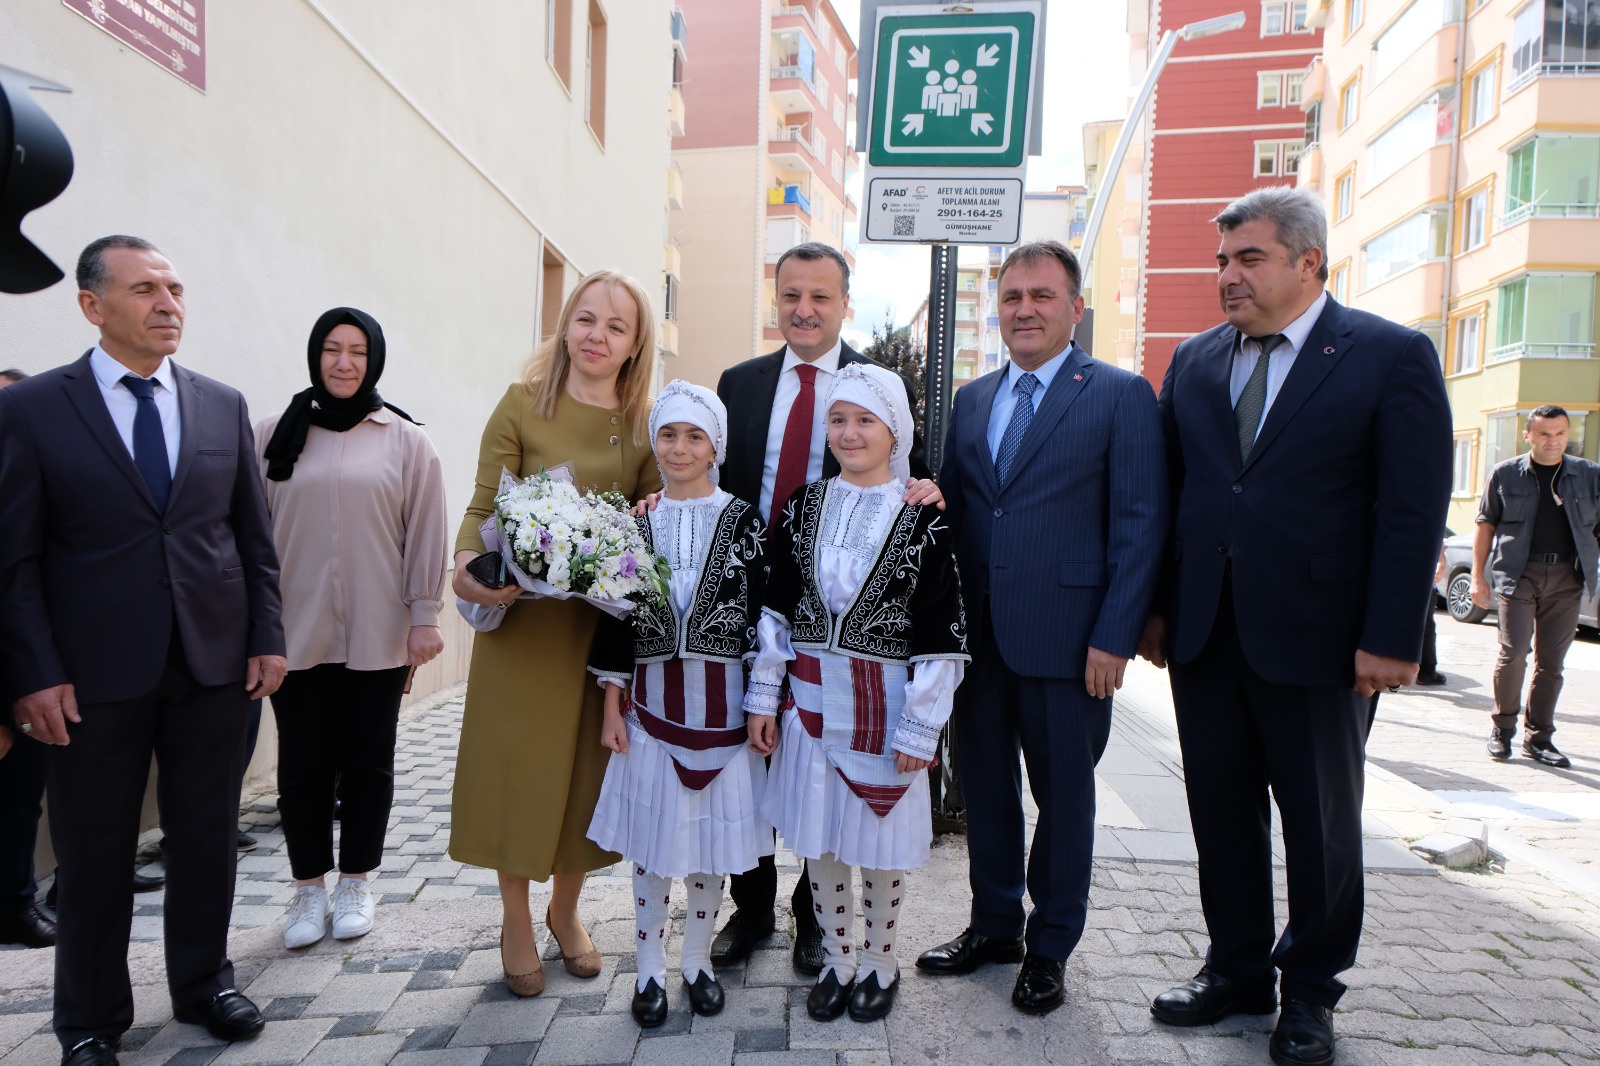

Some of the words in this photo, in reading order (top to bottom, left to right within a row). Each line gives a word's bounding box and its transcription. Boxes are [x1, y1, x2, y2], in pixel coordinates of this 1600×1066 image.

[143, 8, 200, 57] YAPILMIŞTIR
[882, 188, 907, 197] AFAD
[937, 187, 954, 195] AFET
[954, 187, 963, 195] VE
[964, 186, 979, 195] ACİL
[979, 187, 1006, 196] DURUM
[941, 197, 978, 206] TOPLANMA
[979, 198, 1000, 206] ALANI
[936, 208, 1003, 218] 2901-164-25
[945, 222, 992, 231] GÜMÜŞHANE
